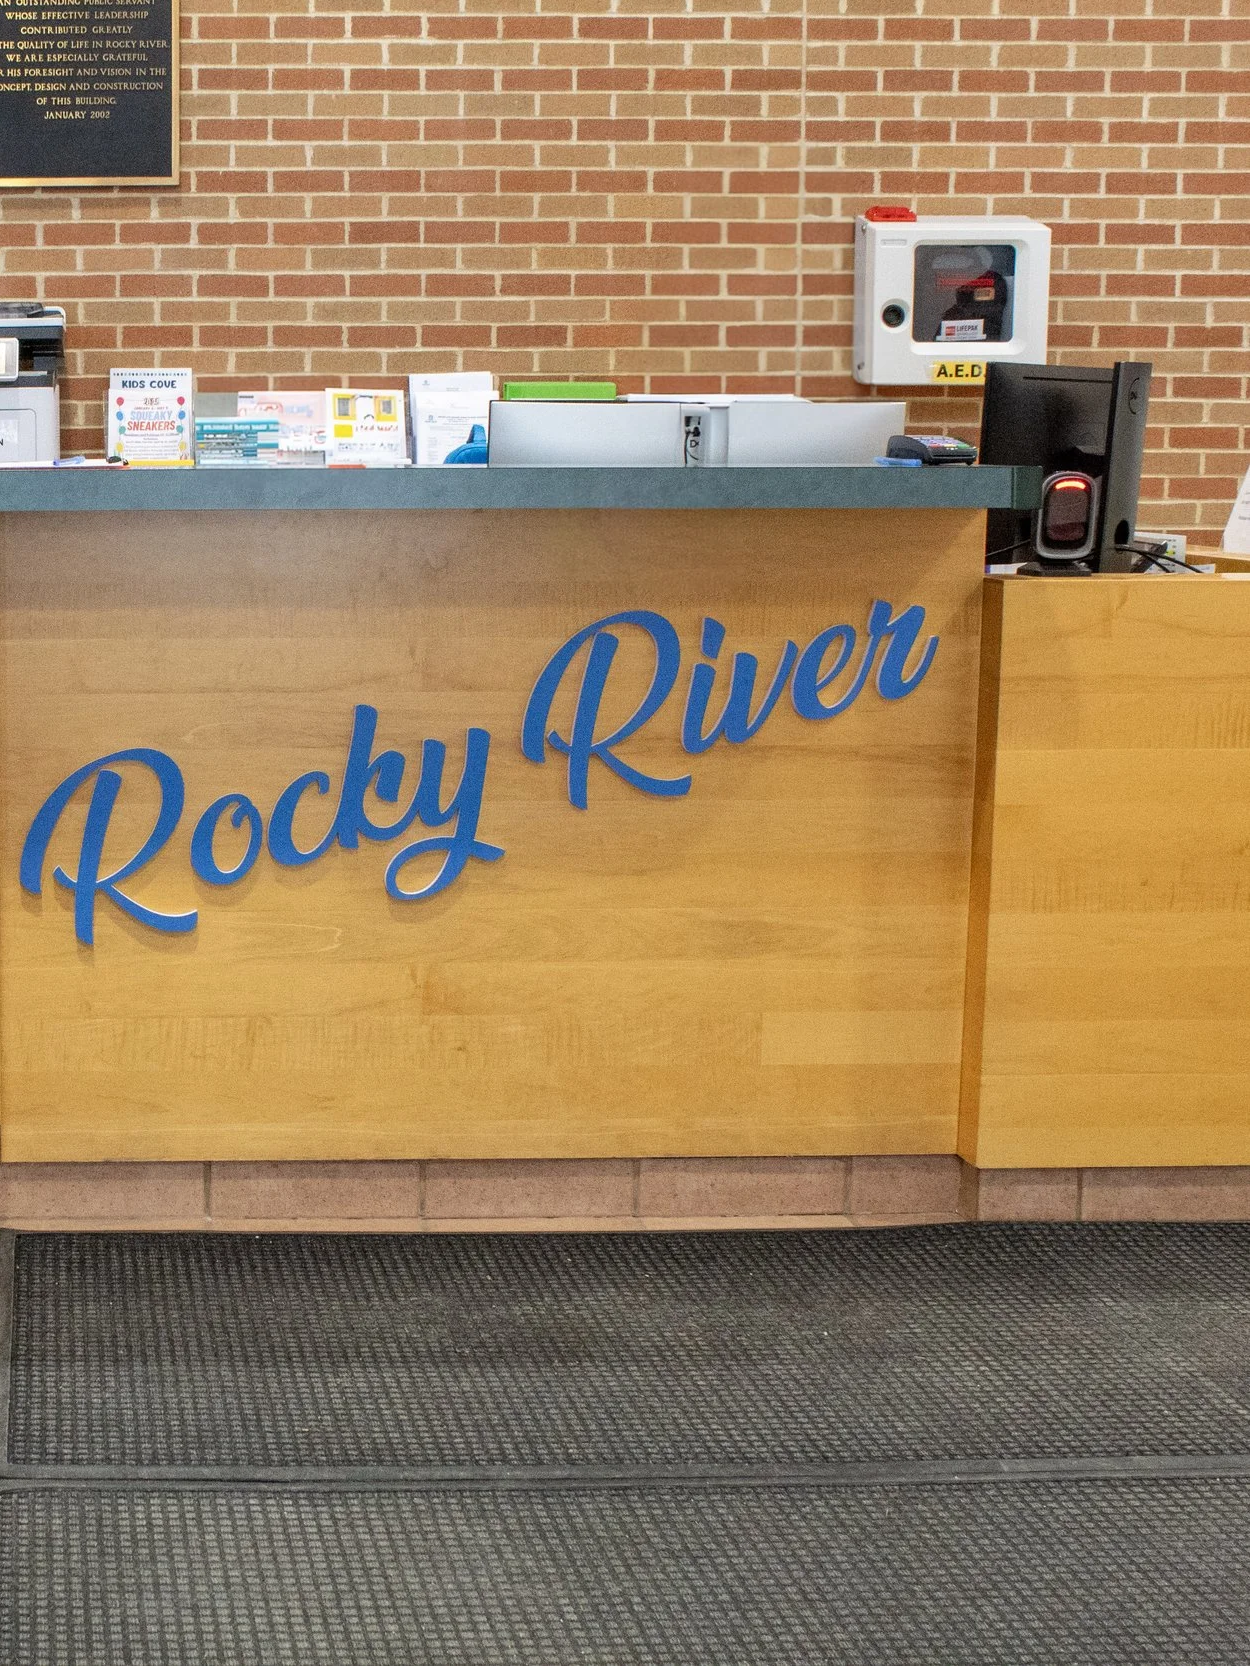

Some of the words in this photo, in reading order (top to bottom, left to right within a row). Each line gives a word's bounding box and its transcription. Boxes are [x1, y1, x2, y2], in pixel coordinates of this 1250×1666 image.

[5, 12, 38, 20] WHOSE
[41, 12, 91, 20] EFFECTIVE
[94, 11, 149, 20] LEADERSHIP
[20, 26, 87, 35] CONTRIBUTED
[92, 26, 133, 34] GREATLY
[17, 41, 55, 50] QUALITY
[57, 41, 68, 49] OF
[71, 41, 89, 49] LIFE
[92, 41, 103, 49] IN
[105, 40, 137, 49] ROCKY
[6, 54, 21, 62] WE
[24, 54, 44, 62] ARE
[47, 53, 100, 62] ESPECIALLY
[102, 53, 148, 61] GRATEFUL
[7, 68, 21, 77] HIS
[24, 68, 74, 77] FORESIGHT
[77, 68, 98, 76] AND
[100, 68, 132, 76] VISION
[136, 68, 147, 76] IN
[150, 67, 167, 76] THE
[34, 83, 67, 92] DESIGN
[69, 83, 90, 91] AND
[93, 82, 163, 91] CONSTRUCTION
[36, 97, 47, 106] OF
[51, 97, 71, 105] THIS
[44, 111, 87, 120] JANUARY
[90, 110, 111, 119] 2002
[956, 324, 979, 332] LIFEPAK
[121, 380, 146, 389] KIDS
[150, 380, 177, 389] COVE
[130, 410, 173, 421] SQUEAKY
[127, 420, 176, 431] SNEAKERS
[19, 704, 505, 945] Rocky
[521, 600, 940, 810] River
